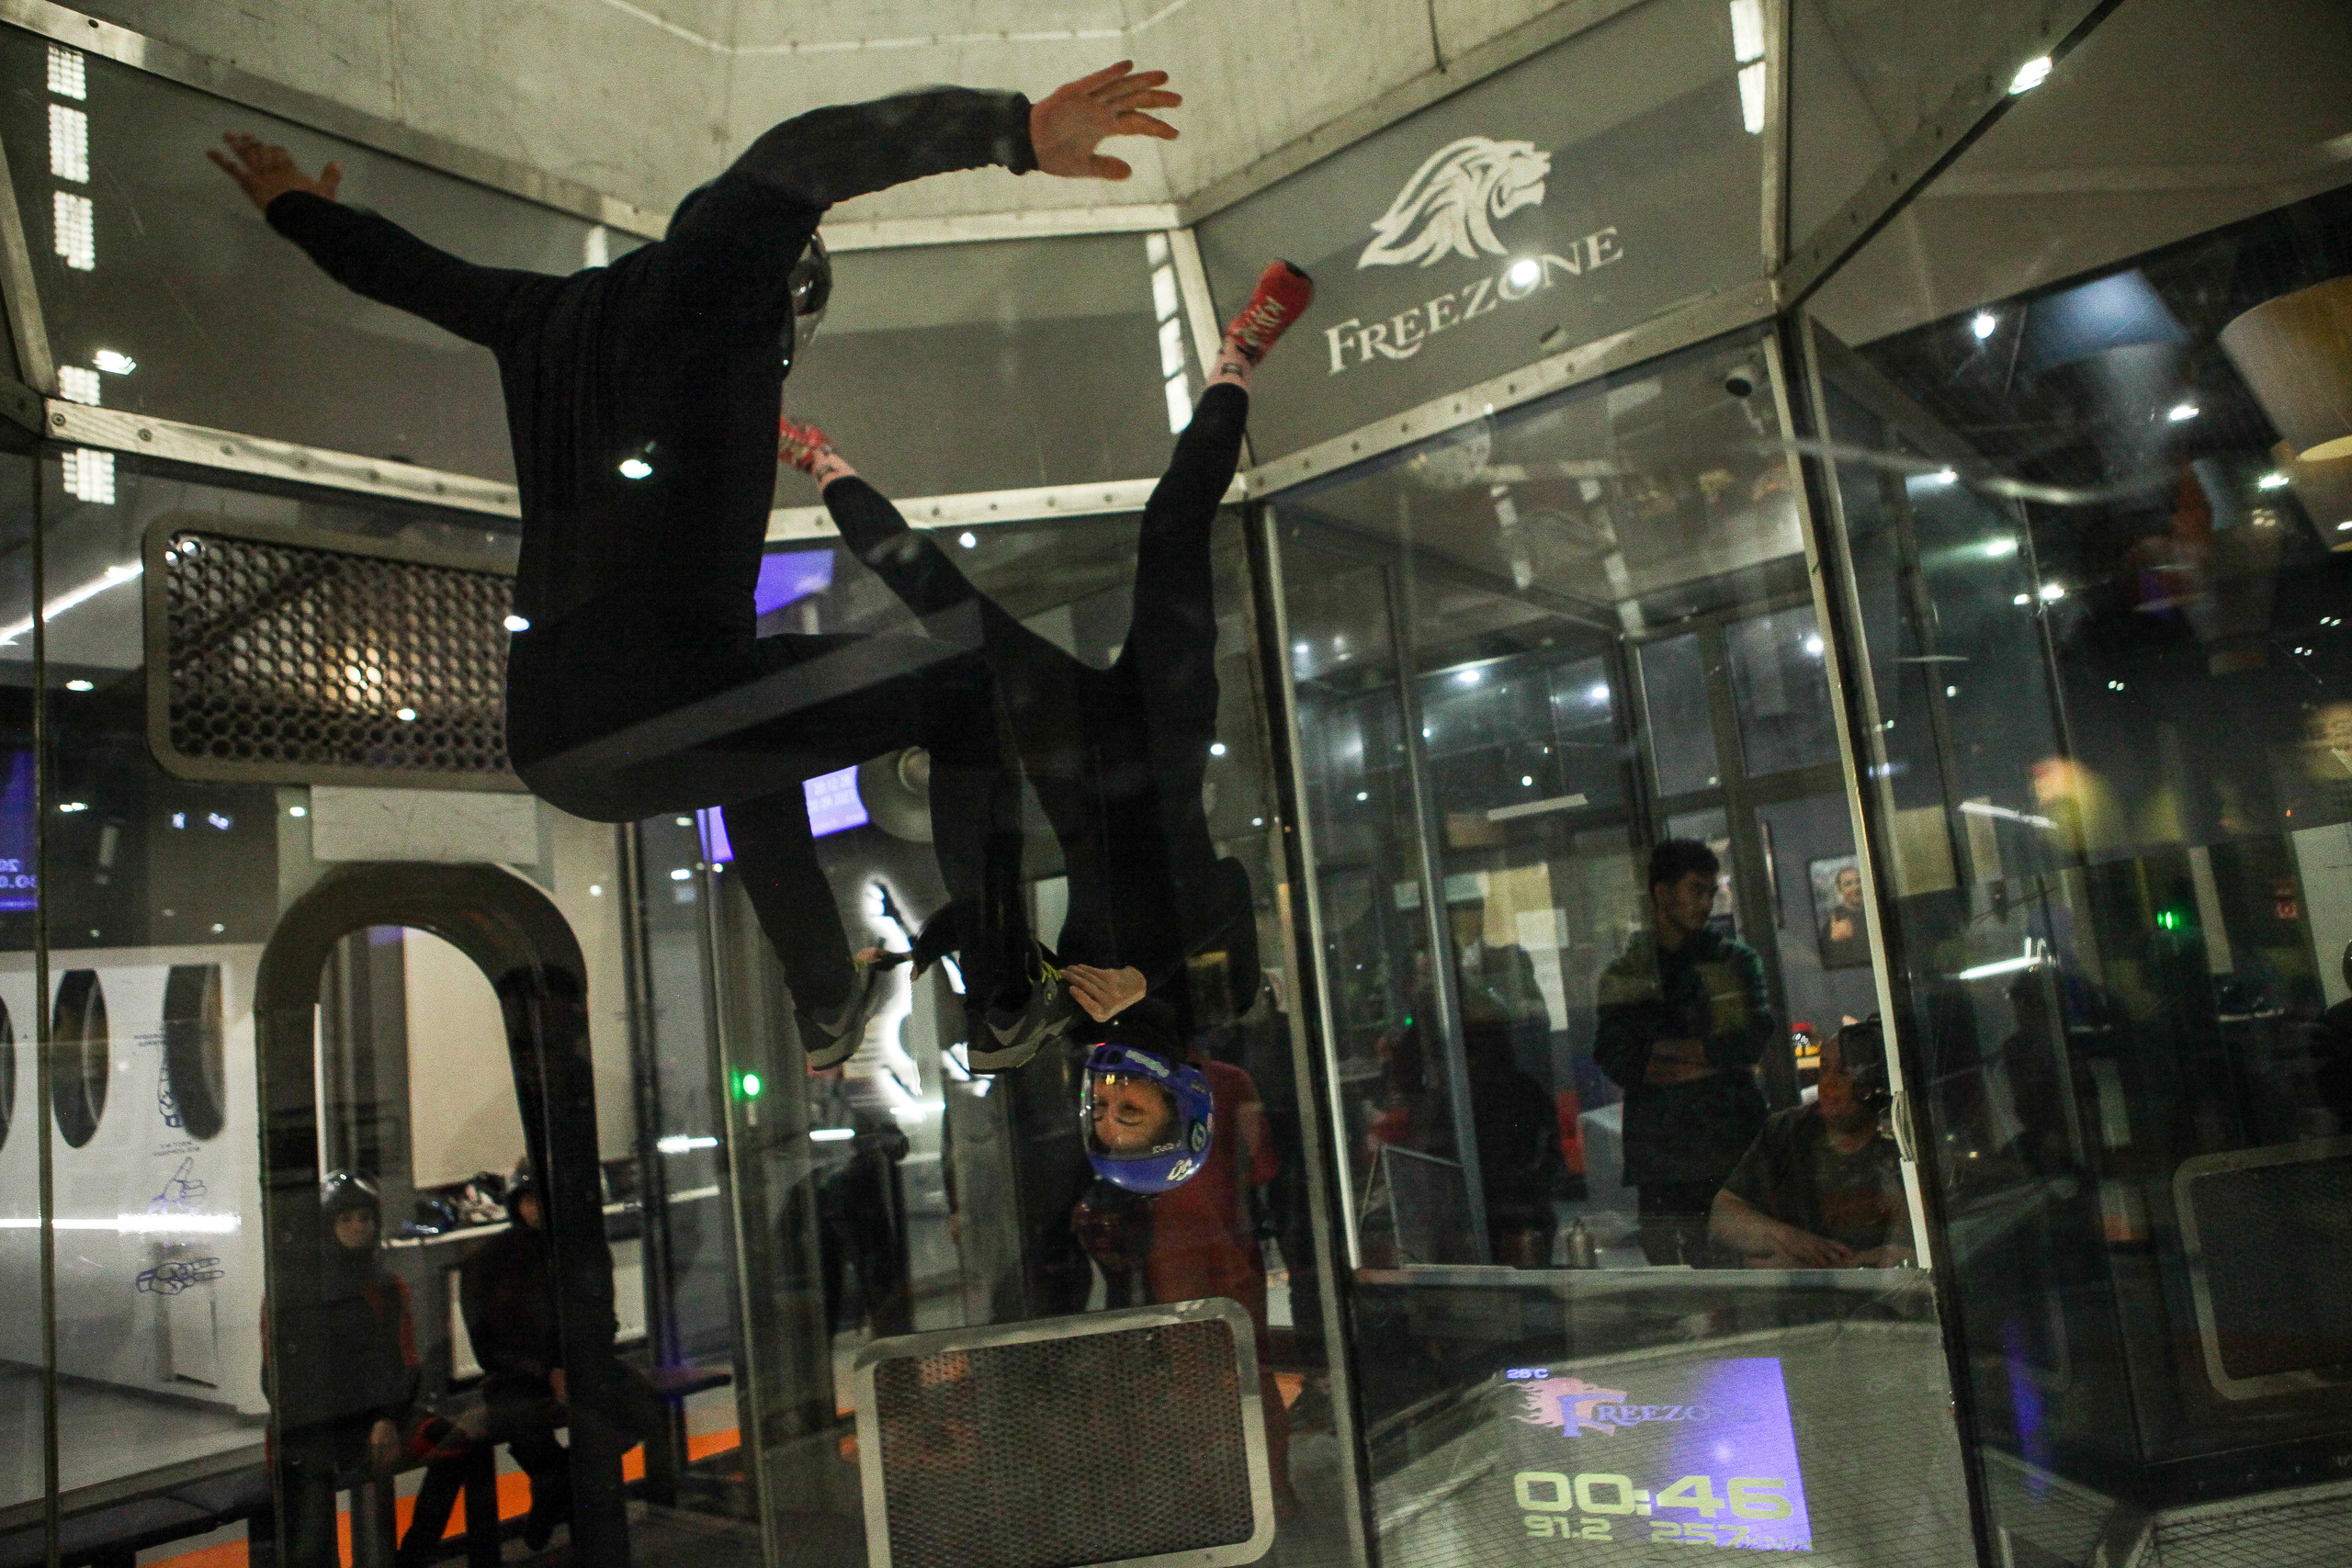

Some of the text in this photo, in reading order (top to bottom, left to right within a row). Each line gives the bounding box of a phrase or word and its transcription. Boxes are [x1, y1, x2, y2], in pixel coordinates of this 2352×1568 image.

[1326, 227, 1623, 376] FREEZONE
[1556, 1393, 1761, 1438] FREEZO
[1514, 1472, 1793, 1520] 00:46
[1523, 1516, 1612, 1540] 91.2
